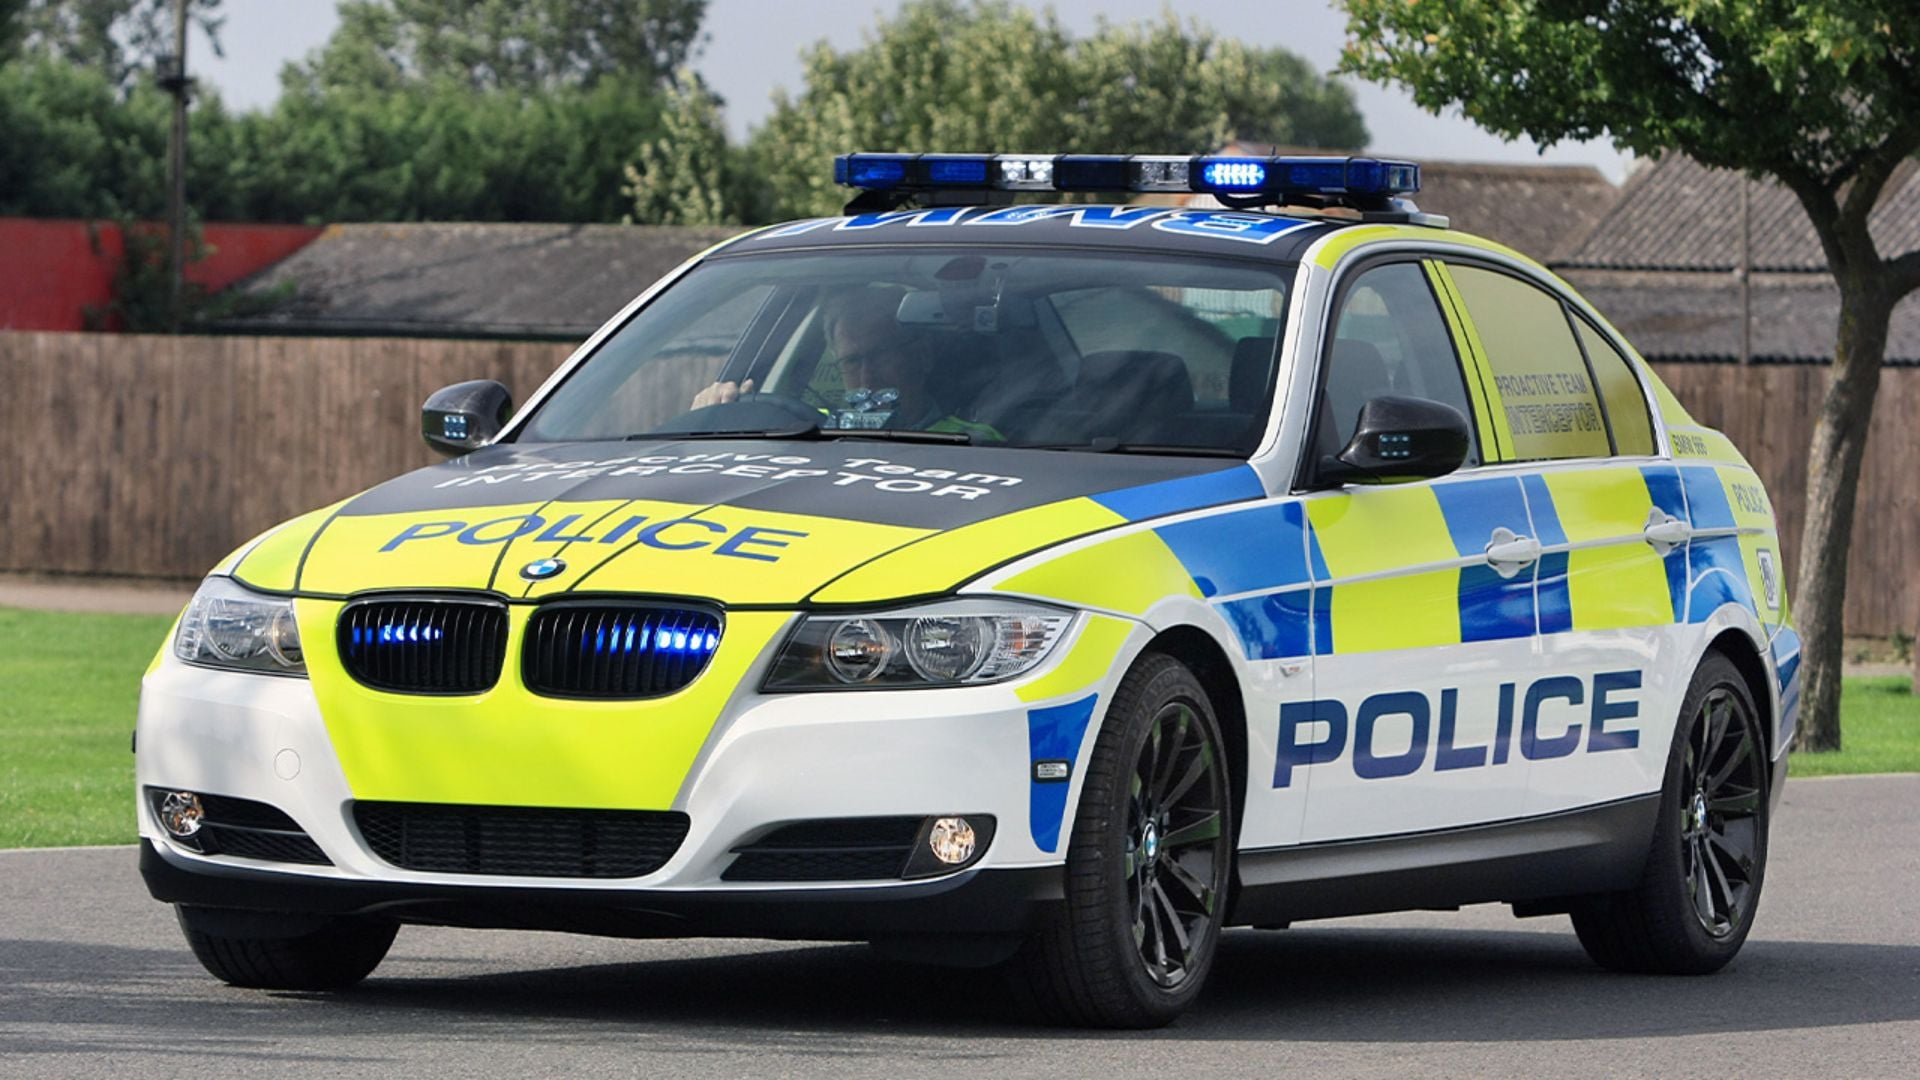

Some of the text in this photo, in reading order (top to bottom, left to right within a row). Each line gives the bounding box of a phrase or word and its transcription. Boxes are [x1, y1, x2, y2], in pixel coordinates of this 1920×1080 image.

[1492, 372, 1588, 396] PROACTIVE TEAM
[432, 463, 991, 501] INTERCEPTOR
[843, 457, 1024, 487] Team
[378, 513, 810, 563] POLICE
[1272, 670, 1642, 789] POLICE
